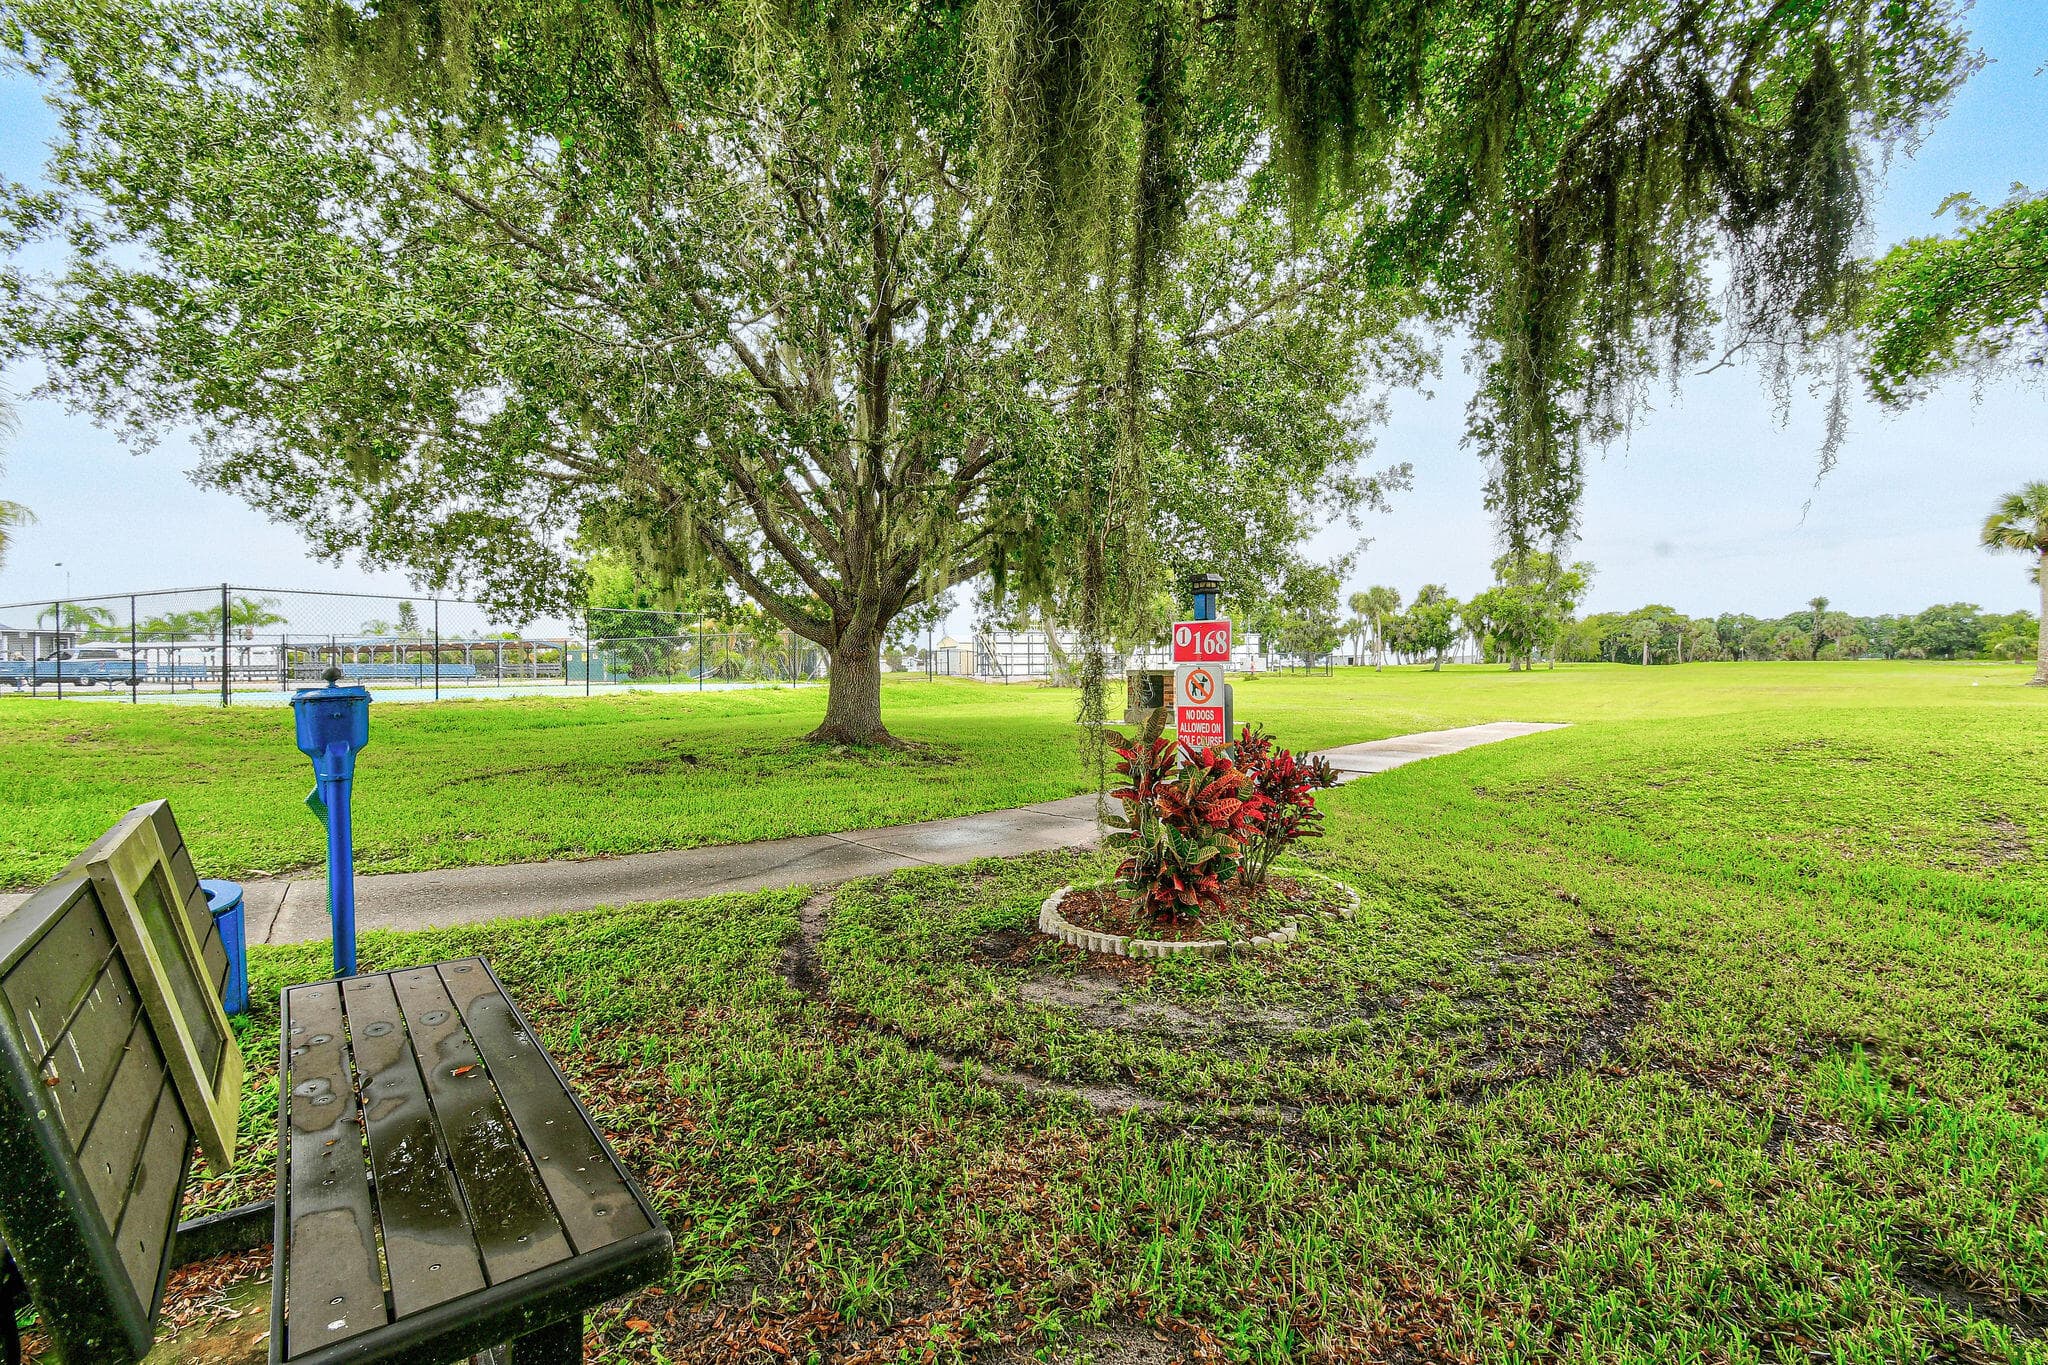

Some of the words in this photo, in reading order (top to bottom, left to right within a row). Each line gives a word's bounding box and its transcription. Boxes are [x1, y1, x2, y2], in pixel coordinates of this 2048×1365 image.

[1192, 630, 1228, 655] 168
[1185, 709, 1195, 720] NO
[1196, 709, 1215, 721] DOGS
[1180, 722, 1210, 734] ALLOWED
[1211, 723, 1221, 734] ON
